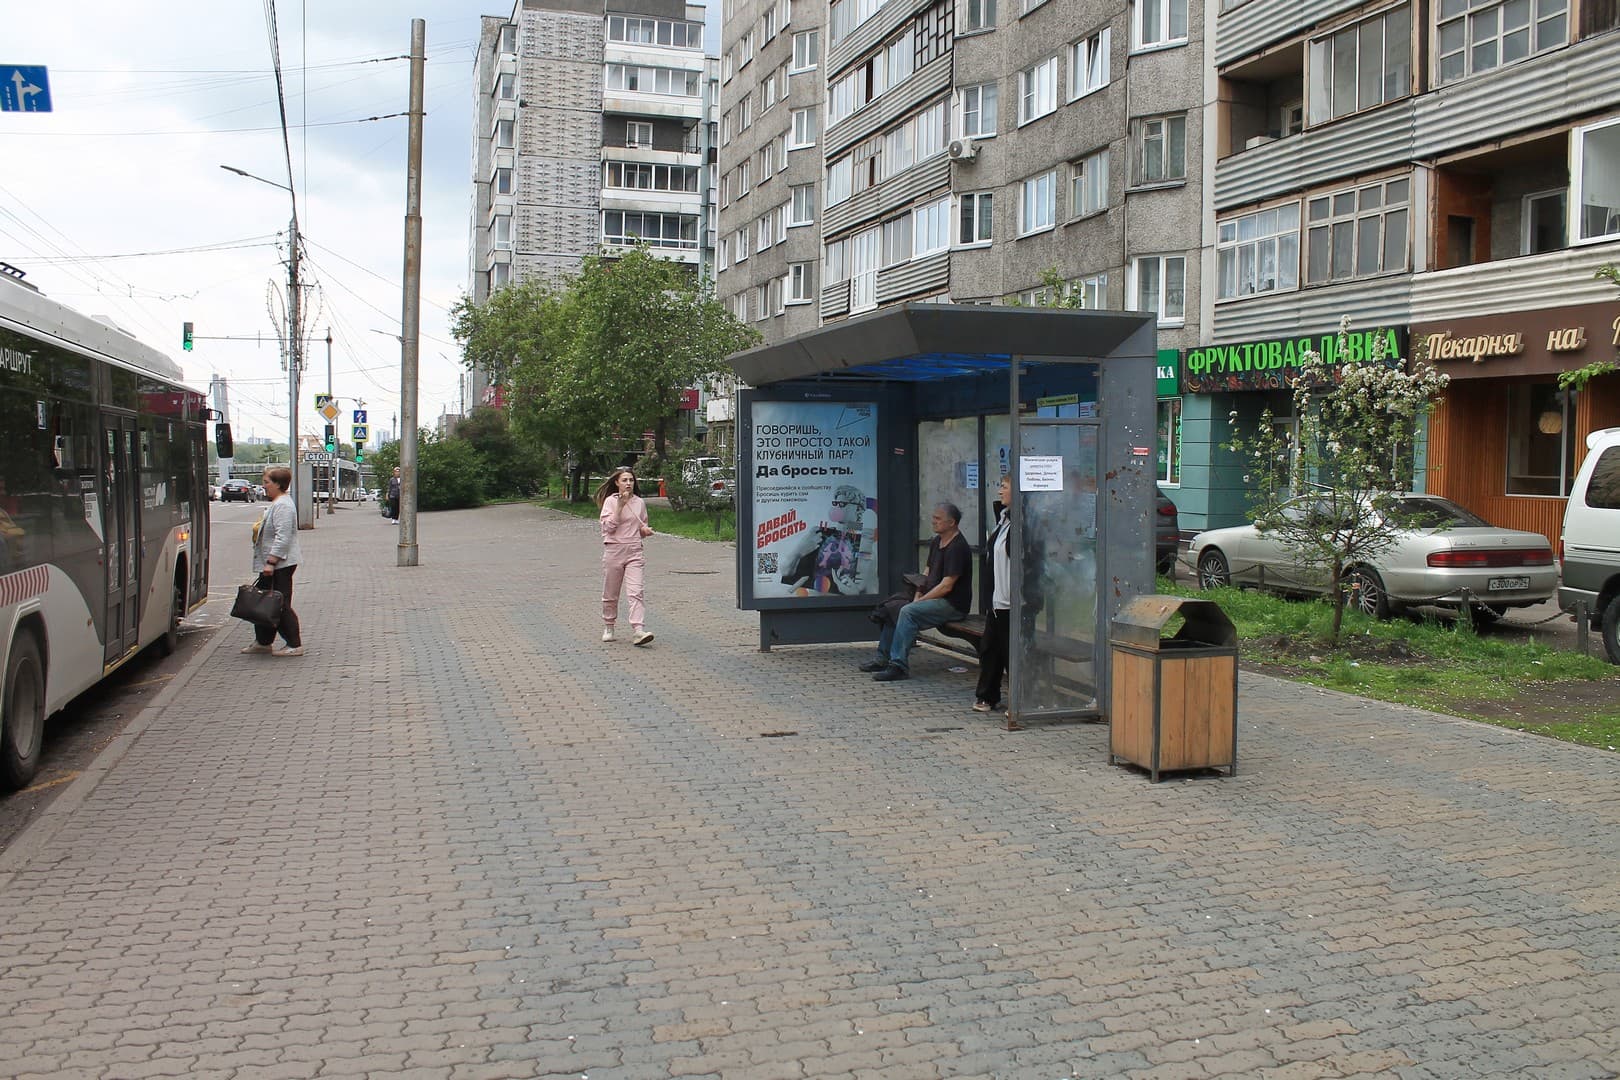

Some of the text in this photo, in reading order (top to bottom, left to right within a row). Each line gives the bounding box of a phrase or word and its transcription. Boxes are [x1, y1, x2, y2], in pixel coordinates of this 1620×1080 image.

[1428, 333, 1524, 363] Пекарня
[1547, 327, 1587, 351] на
[1187, 338, 1312, 375] ФРУКТОВАЯ
[756, 424, 822, 436] ГОВОРИШЬ,
[756, 434, 871, 448] ЭТО ПРОСТО ТАКОЙ
[308, 452, 331, 460] СТОП
[828, 449, 854, 460] ПАР?
[756, 464, 854, 479] Да брось ты.
[757, 508, 798, 538] ДАВАЙ
[757, 520, 807, 550] БРОСАТЬ
